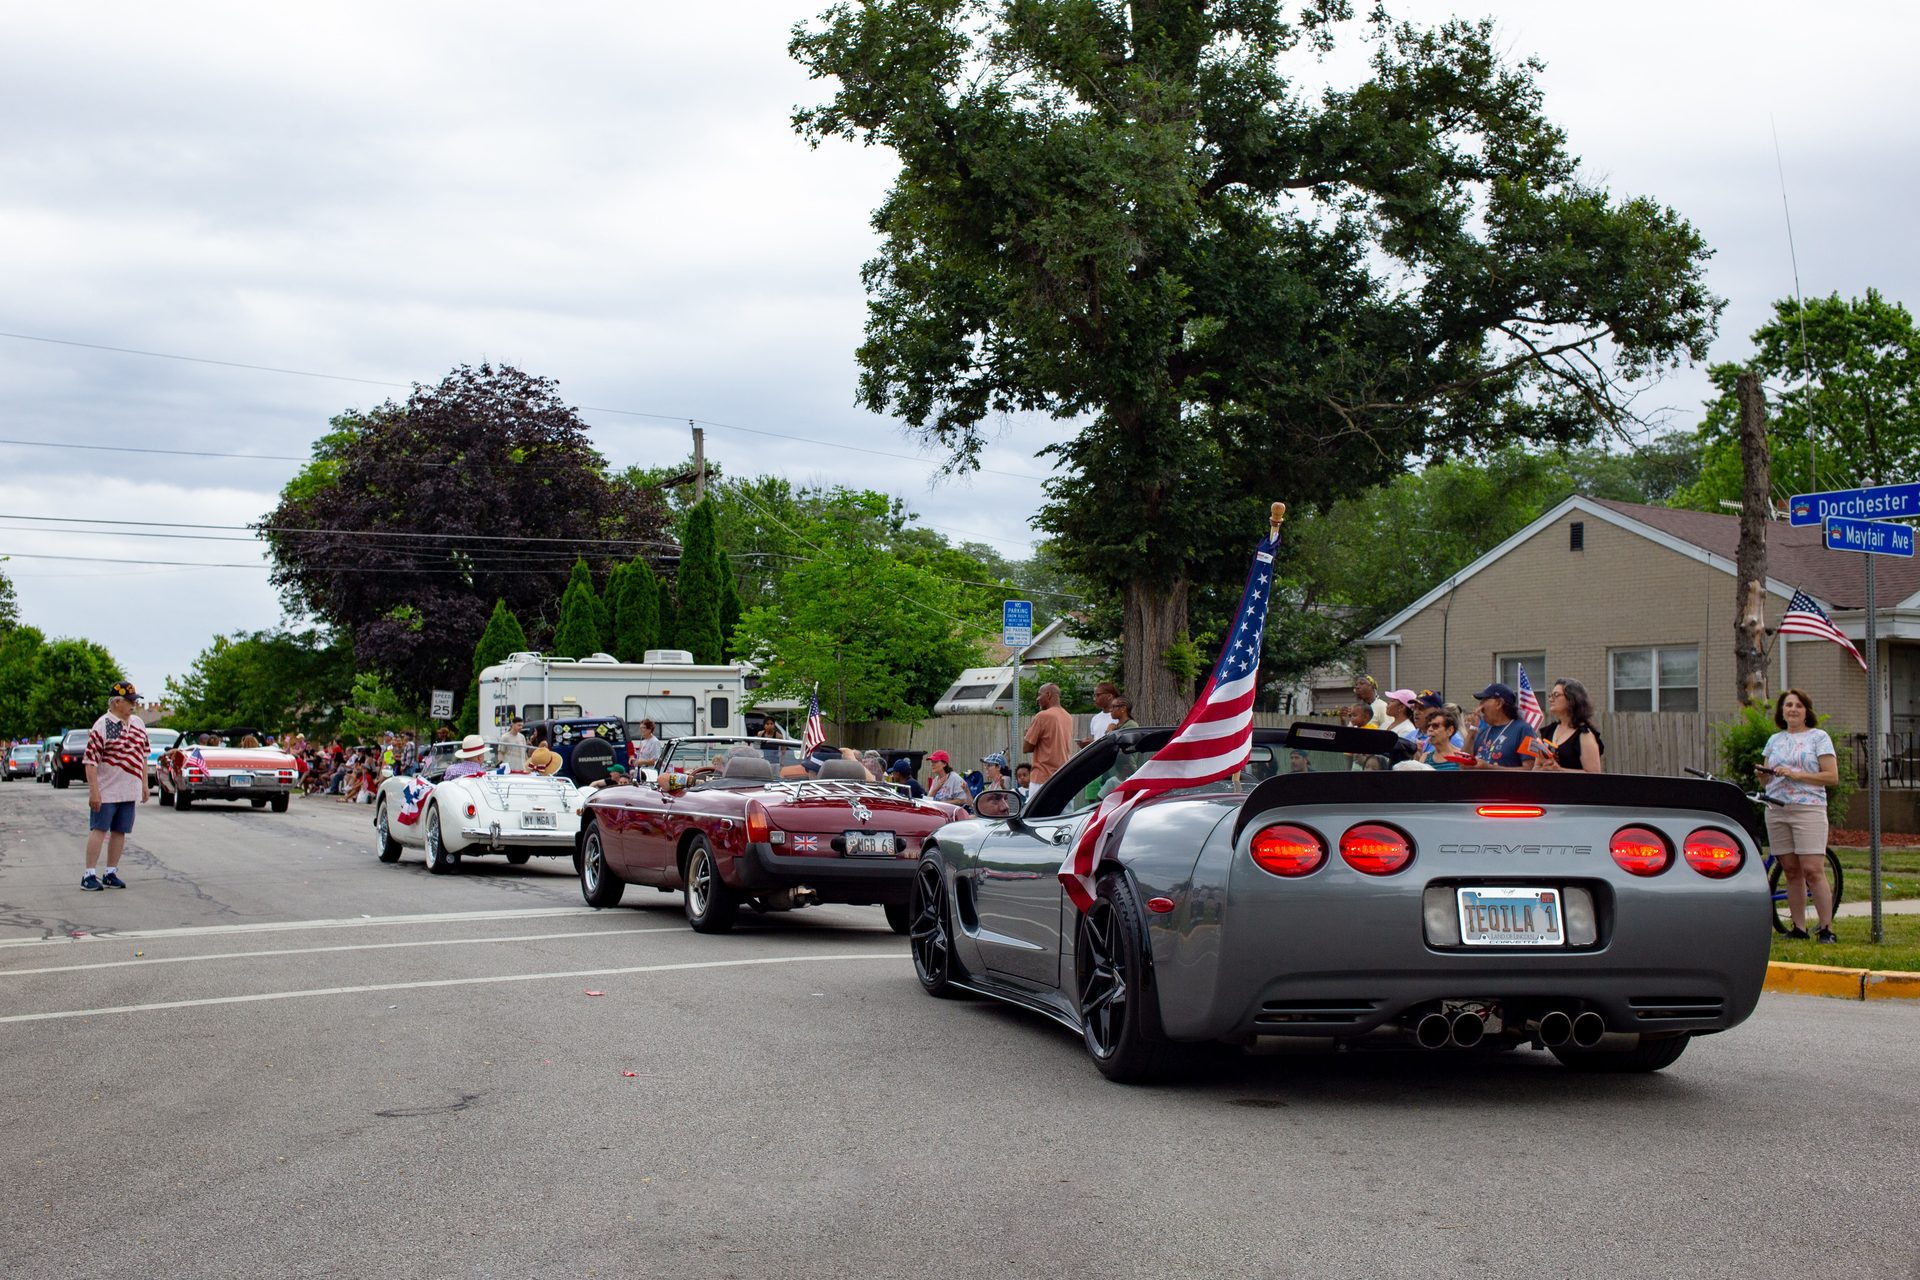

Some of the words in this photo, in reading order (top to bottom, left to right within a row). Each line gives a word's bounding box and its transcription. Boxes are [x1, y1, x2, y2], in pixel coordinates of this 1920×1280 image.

[1819, 493, 1908, 517] Dorchester
[1846, 525, 1885, 549] Mayfair
[1891, 530, 1909, 549] Ave
[432, 704, 450, 716] 25
[524, 815, 533, 825] MY
[857, 838, 876, 852] MGB
[1438, 844, 1593, 855] CORVETTE
[1464, 904, 1535, 933] TEQILA
[1544, 904, 1557, 933] 1
